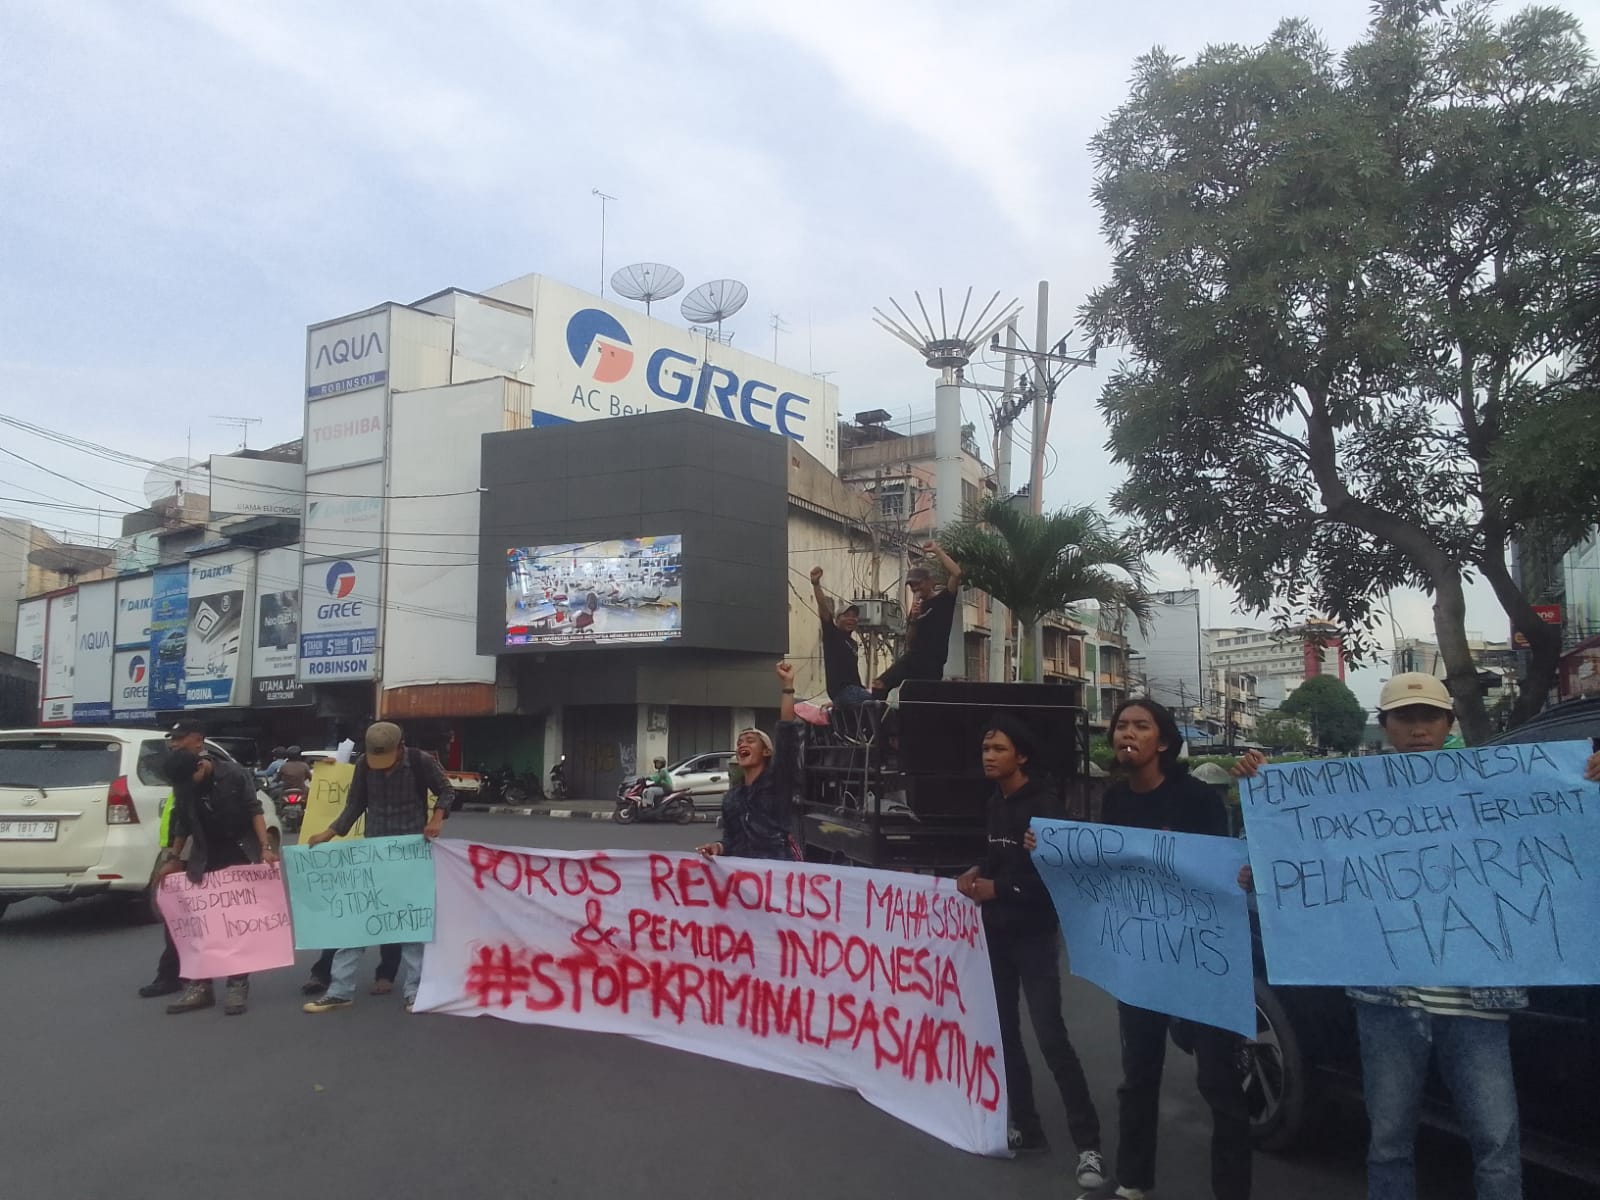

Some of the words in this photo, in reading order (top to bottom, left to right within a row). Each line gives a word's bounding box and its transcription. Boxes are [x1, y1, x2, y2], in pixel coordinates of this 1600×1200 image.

[316, 331, 383, 369] AQUA
[320, 374, 376, 395] ROBINSON
[570, 384, 601, 412] AC
[646, 347, 810, 442] GREE
[313, 415, 381, 443] TOSHIBA
[200, 564, 232, 580] DAIKIN
[128, 598, 153, 611] DAIK
[317, 601, 362, 620] GREE
[80, 631, 110, 650] AQUA
[326, 639, 334, 656] 5
[351, 637, 361, 654] 10
[309, 659, 367, 675] ROBINSON
[123, 685, 148, 699] GREE
[186, 687, 213, 701] ROBINA
[259, 679, 284, 692] UTAMA
[1248, 761, 1370, 806] PEMIMPIN
[1382, 744, 1560, 788] INDONESIA
[0, 823, 10, 833] BK
[17, 823, 38, 832] 1817
[1280, 803, 1368, 841] TIDAK
[1364, 804, 1459, 839] BOLEH
[1459, 788, 1585, 829] TERLIBAT
[293, 845, 383, 875] INDONESIA
[1040, 826, 1124, 870] STOP
[306, 866, 375, 892] PEMIMPIN
[1271, 832, 1583, 910] PELANGGARAN
[343, 887, 389, 914] TIDAK
[648, 853, 841, 923] REVOLUSI
[866, 878, 980, 948] MAHASISWA
[1069, 870, 1224, 930] KRIMINALISASI
[222, 912, 291, 939] INDONESIA
[1374, 882, 1564, 970] HAM
[1100, 906, 1229, 976] AKTIVIS
[570, 898, 620, 948] &
[628, 908, 756, 969] PEMUDA
[776, 929, 966, 1015] INDONESIA
